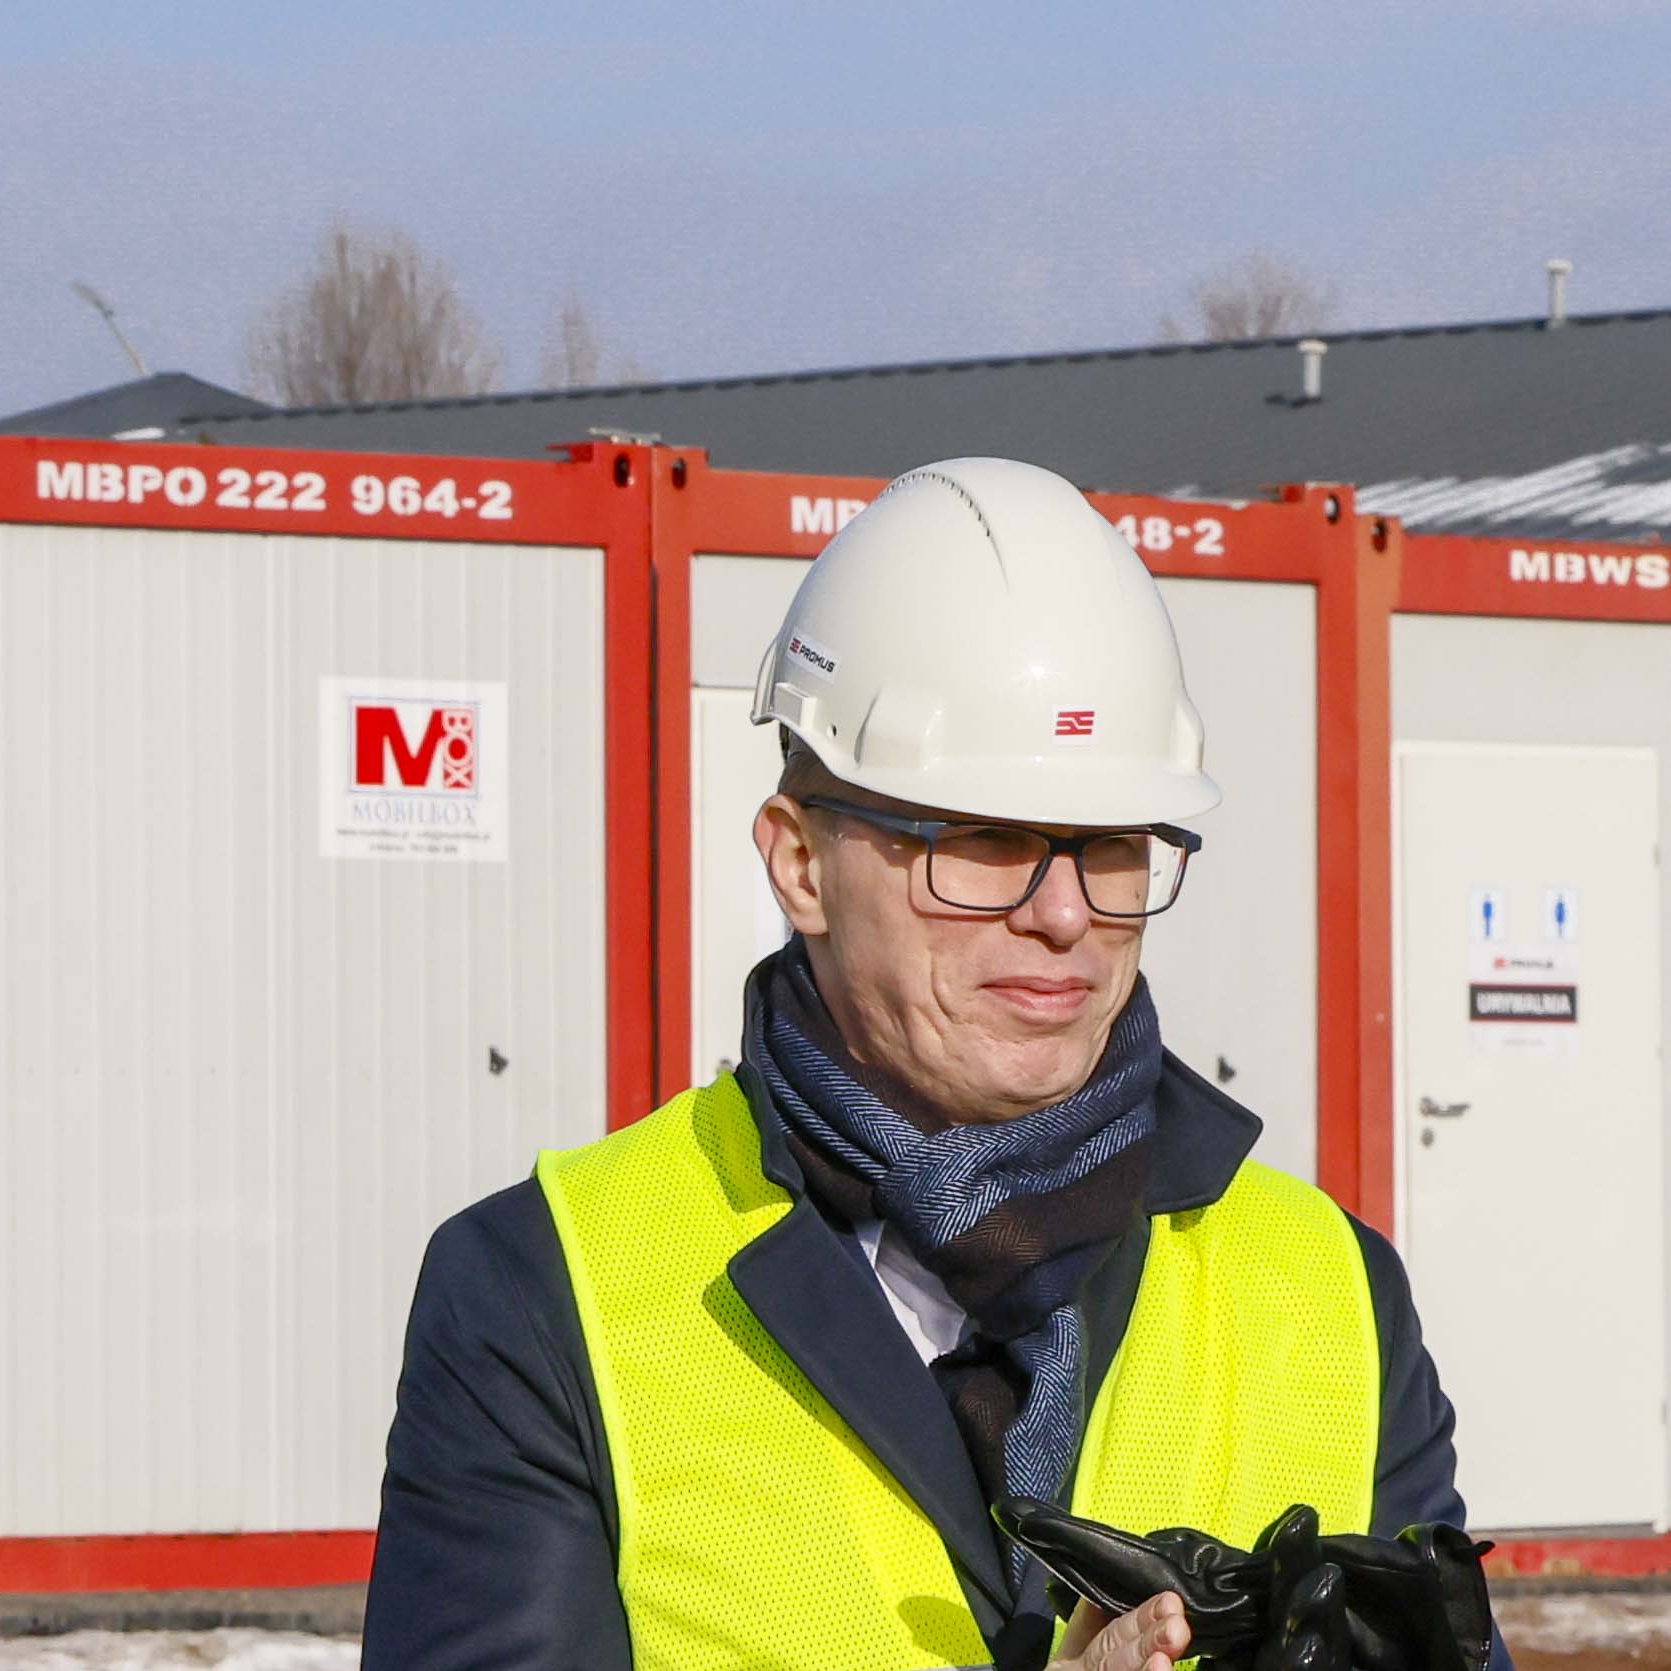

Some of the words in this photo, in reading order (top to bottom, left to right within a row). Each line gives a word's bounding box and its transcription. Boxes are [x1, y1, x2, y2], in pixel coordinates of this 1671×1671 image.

[36, 460, 207, 507] MBPO
[215, 467, 327, 511] 222
[350, 474, 513, 520] 964-2
[1510, 549, 1671, 589] MBWS
[799, 644, 836, 673] PROMUS
[442, 708, 473, 789] BOX
